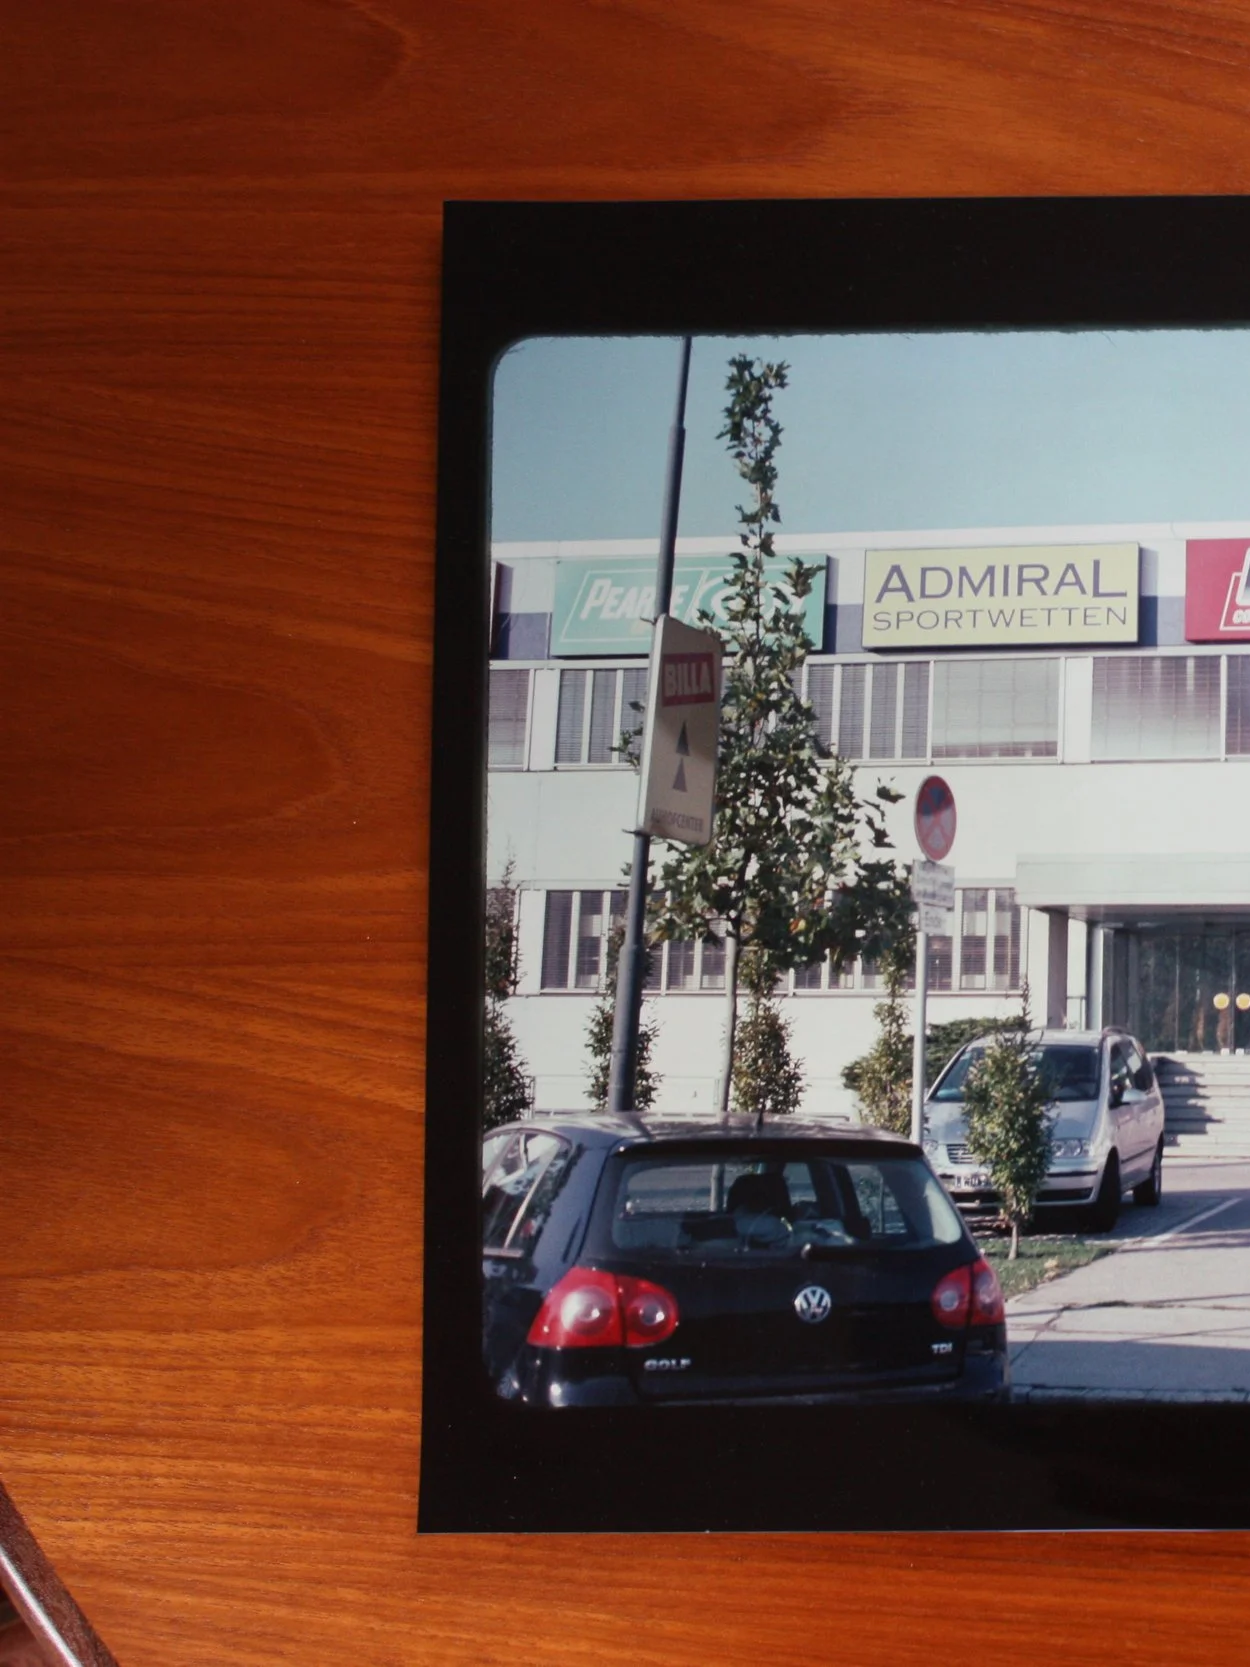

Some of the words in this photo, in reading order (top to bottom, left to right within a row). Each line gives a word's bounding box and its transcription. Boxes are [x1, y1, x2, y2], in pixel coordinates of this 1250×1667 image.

[580, 578, 690, 620] PEARE
[875, 559, 1128, 603] ADMIRAL
[872, 606, 1128, 631] SPORTWETTEN
[664, 661, 711, 698] BILLA
[644, 1358, 692, 1371] GOLF
